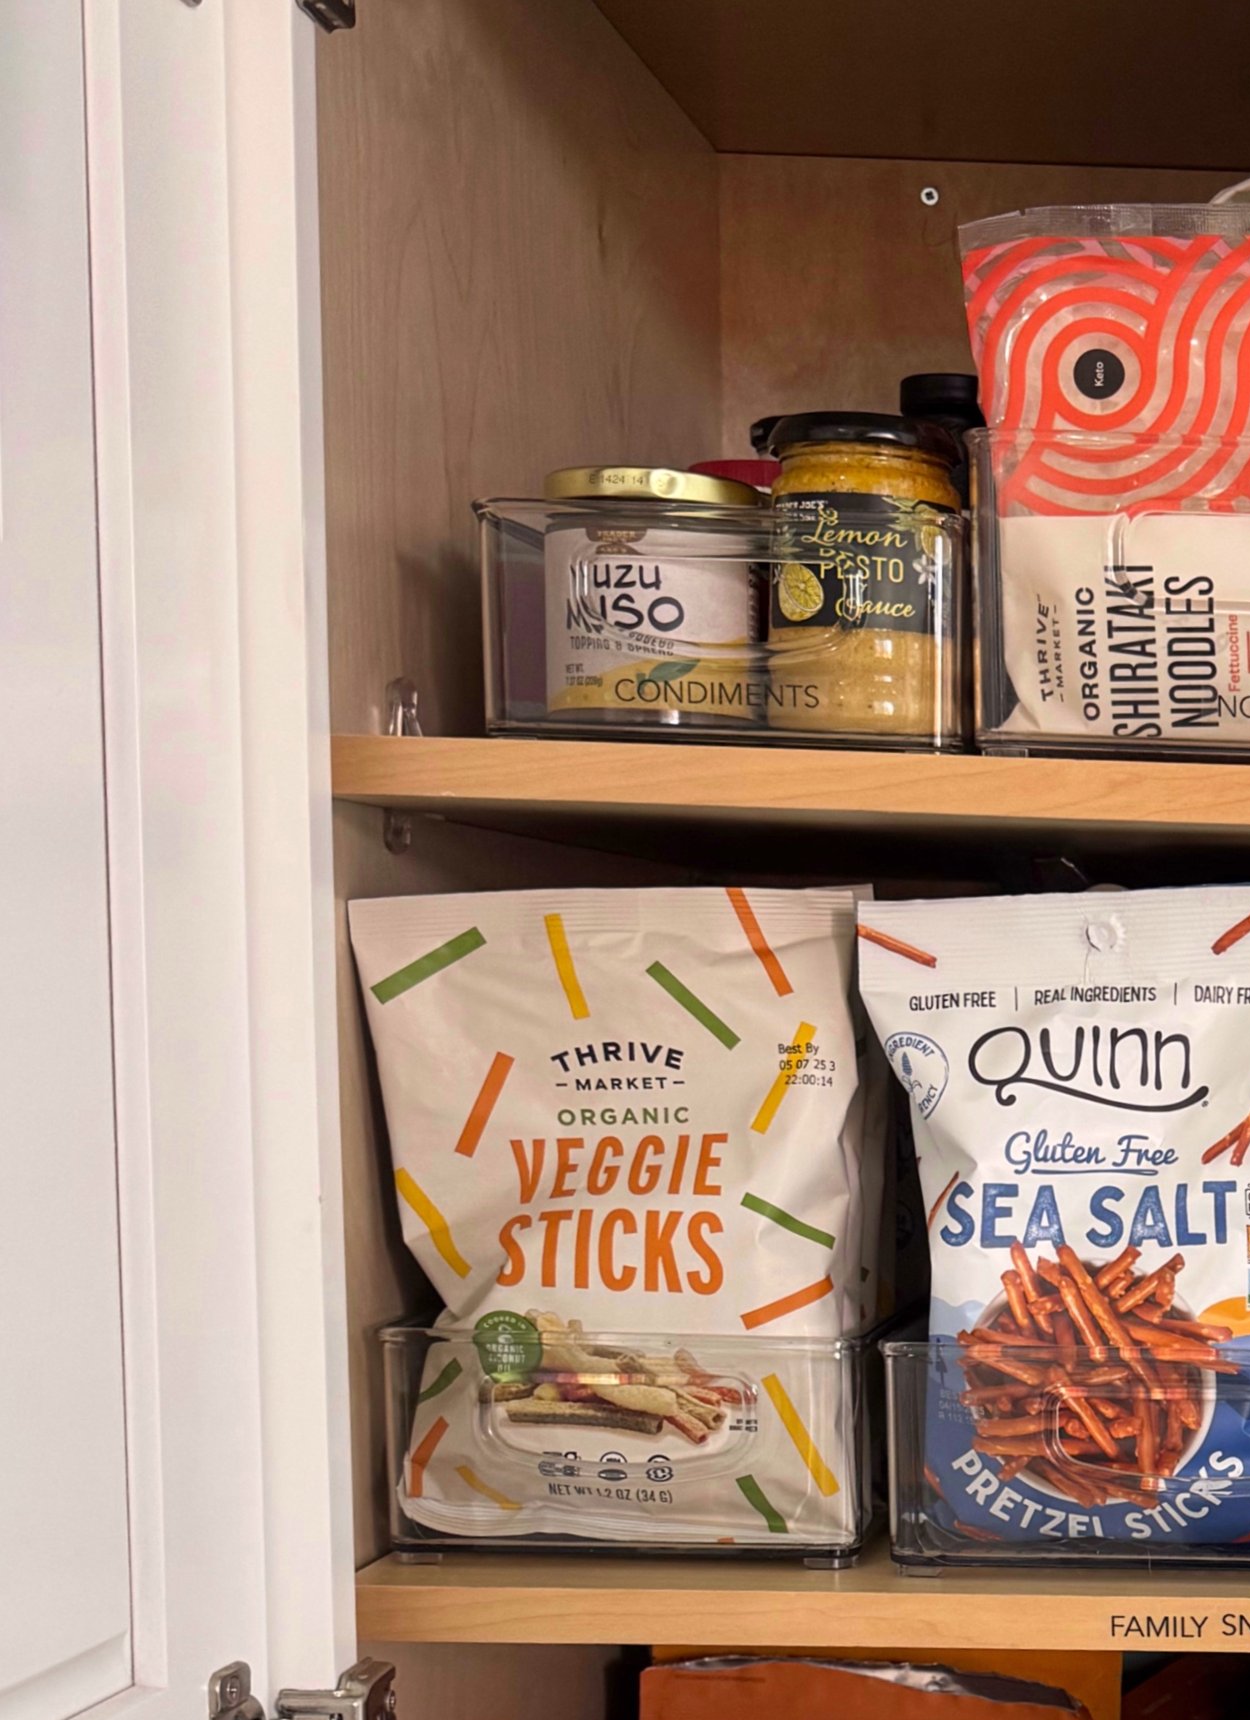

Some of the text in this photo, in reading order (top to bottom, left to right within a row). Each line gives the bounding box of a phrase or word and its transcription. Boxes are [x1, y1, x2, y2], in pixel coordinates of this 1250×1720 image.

[1094, 361, 1105, 388] Keto
[801, 507, 908, 548] Lemon
[1075, 587, 1101, 722] ORGANIC
[1163, 574, 1219, 729] NOODLES
[1228, 613, 1240, 693] Fettuccine
[615, 677, 819, 709] CONDIMENTS
[909, 991, 997, 1011] GLUTEN FREE
[1034, 986, 1157, 1005] REAL INGREDIENTS
[1194, 985, 1235, 1004] DAIRY
[550, 1041, 685, 1074] THRIVE
[777, 1042, 820, 1058] Best By
[575, 1076, 668, 1092] MARKET
[785, 1073, 834, 1087] 22:00:14
[557, 1106, 690, 1127] ORGANIC
[1005, 1129, 1178, 1175] Gluten Free
[509, 1132, 729, 1205] VEGGIE
[939, 1180, 1237, 1250] SEA SALT
[495, 1208, 724, 1296] STICKS
[951, 1448, 1245, 1541] PRETZEL STICKS
[1110, 1614, 1208, 1639] FAMILY
